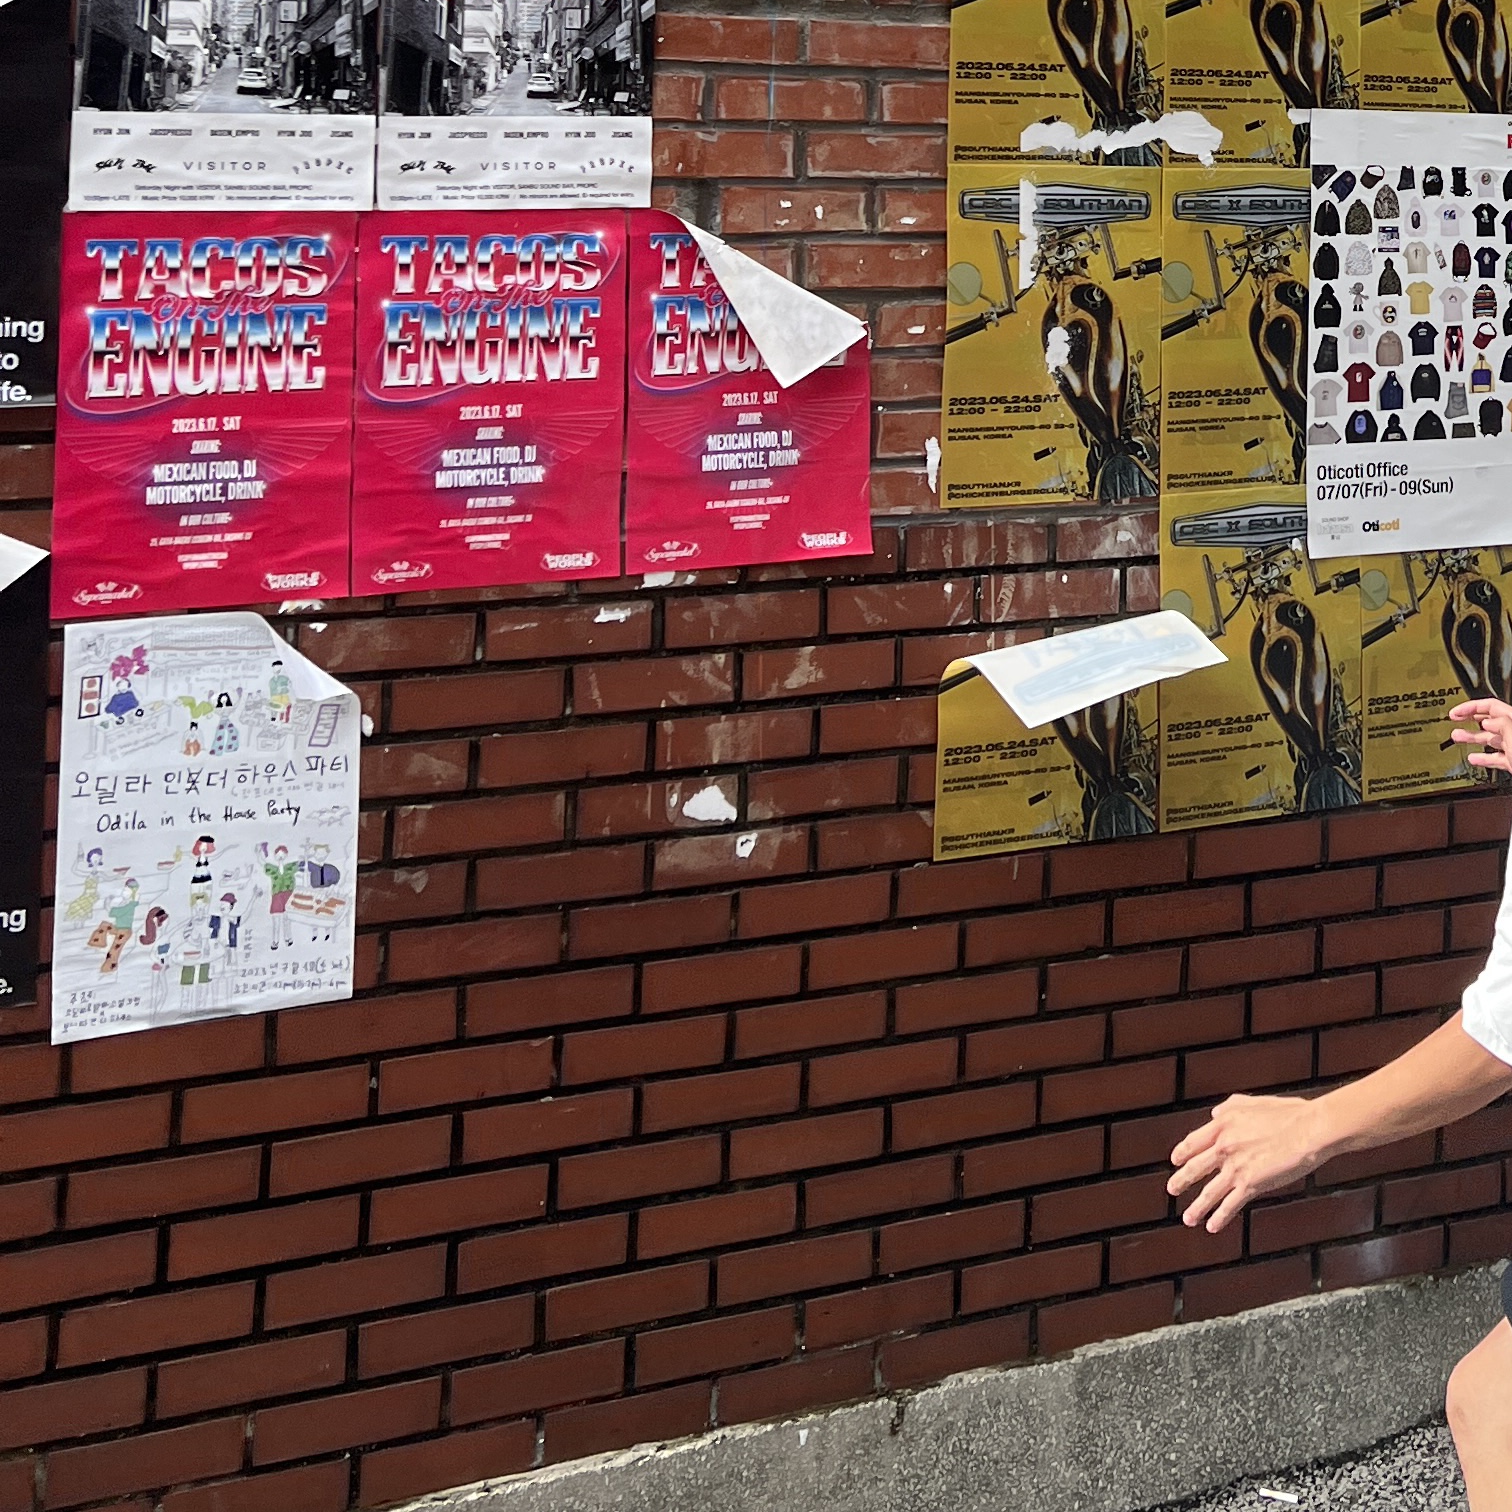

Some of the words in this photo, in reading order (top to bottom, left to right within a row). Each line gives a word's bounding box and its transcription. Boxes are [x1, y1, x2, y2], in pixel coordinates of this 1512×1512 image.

[183, 161, 267, 172] VISITOR
[480, 161, 556, 171] VISITOR
[86, 236, 328, 301] TACOS
[381, 233, 601, 295] TACOS
[0, 316, 45, 343] ing
[85, 304, 328, 400] ENGINE
[381, 297, 601, 388] ENGINE
[0, 351, 20, 371] o
[0, 380, 33, 402] fe.
[763, 391, 778, 404] SAT
[506, 404, 523, 418] SAT
[222, 416, 242, 431] SAT
[782, 430, 792, 446] DJ
[524, 445, 537, 462] DJ
[152, 461, 206, 483] MEXICAN
[243, 460, 257, 478] DJ
[1317, 463, 1363, 480] Oticoti
[1366, 462, 1408, 477] Office
[145, 483, 226, 506] MOTORCYCLE,
[1317, 480, 1388, 500] 07/07(Fri)
[1399, 477, 1454, 495] 09(Sun)
[1362, 518, 1400, 532] Oticoti
[71, 771, 153, 805] 오딜라
[234, 760, 298, 785] 하우스
[305, 754, 349, 778] 파티
[97, 810, 147, 833] Odila
[160, 810, 175, 826] in
[188, 806, 212, 824] the
[266, 799, 301, 826] Party
